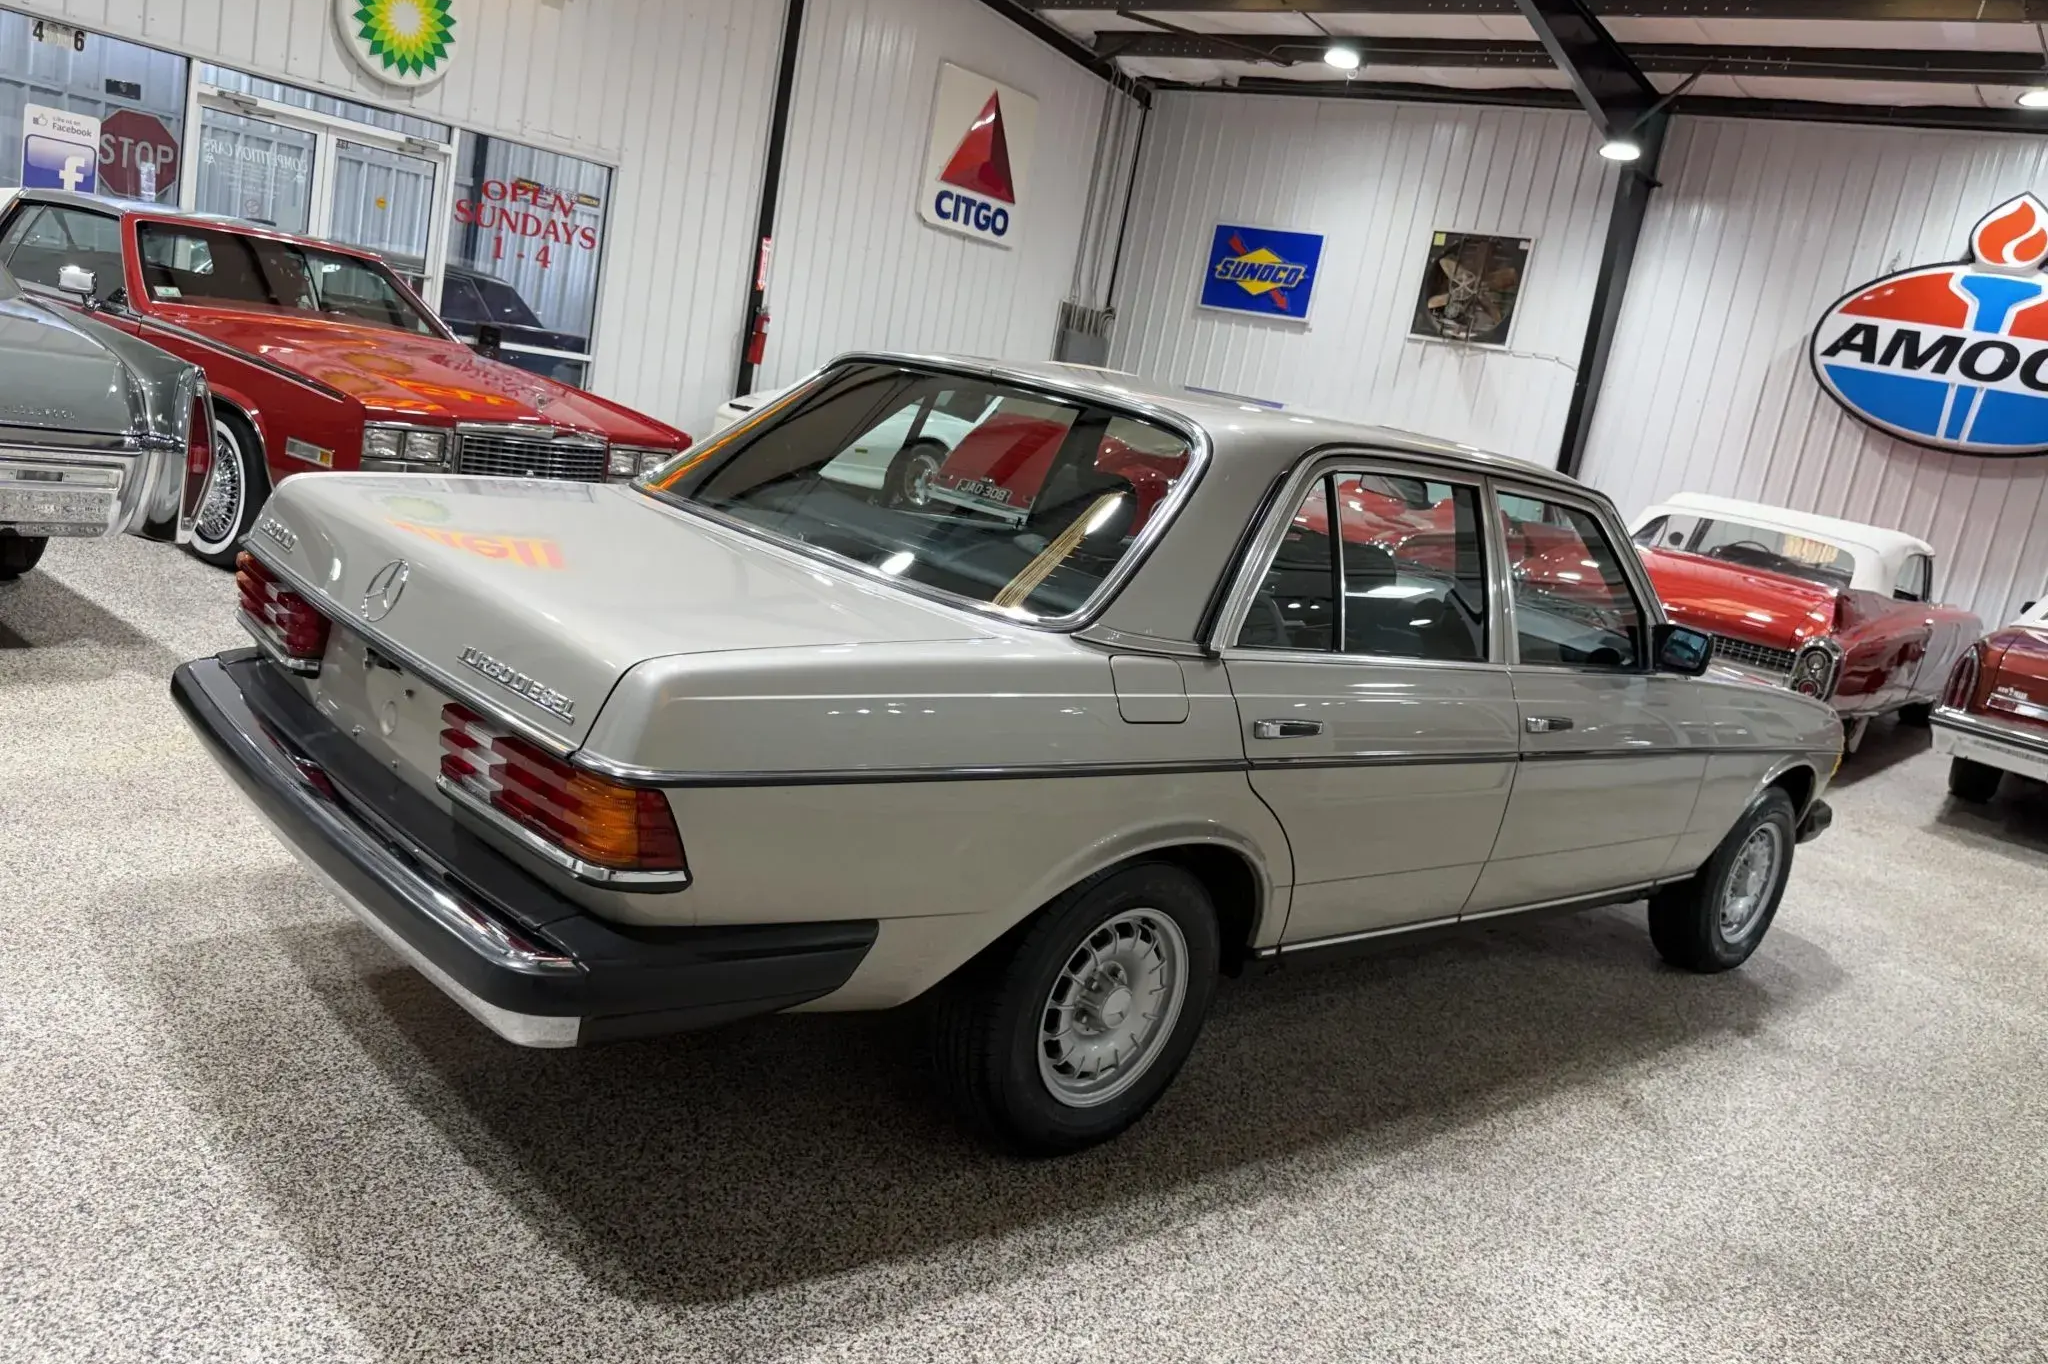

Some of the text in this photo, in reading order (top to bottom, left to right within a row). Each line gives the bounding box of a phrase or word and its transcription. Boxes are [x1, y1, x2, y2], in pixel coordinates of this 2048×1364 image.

[52, 122, 92, 138] Facebook
[98, 133, 175, 175] STOP
[482, 180, 576, 218] OPEN
[935, 190, 1009, 237] CITGO
[454, 198, 597, 249] SUNDAYS
[491, 236, 505, 260] 1
[535, 245, 551, 269] 4
[1216, 258, 1304, 286] SUNOCO
[458, 645, 575, 718] TURBODIESEL
